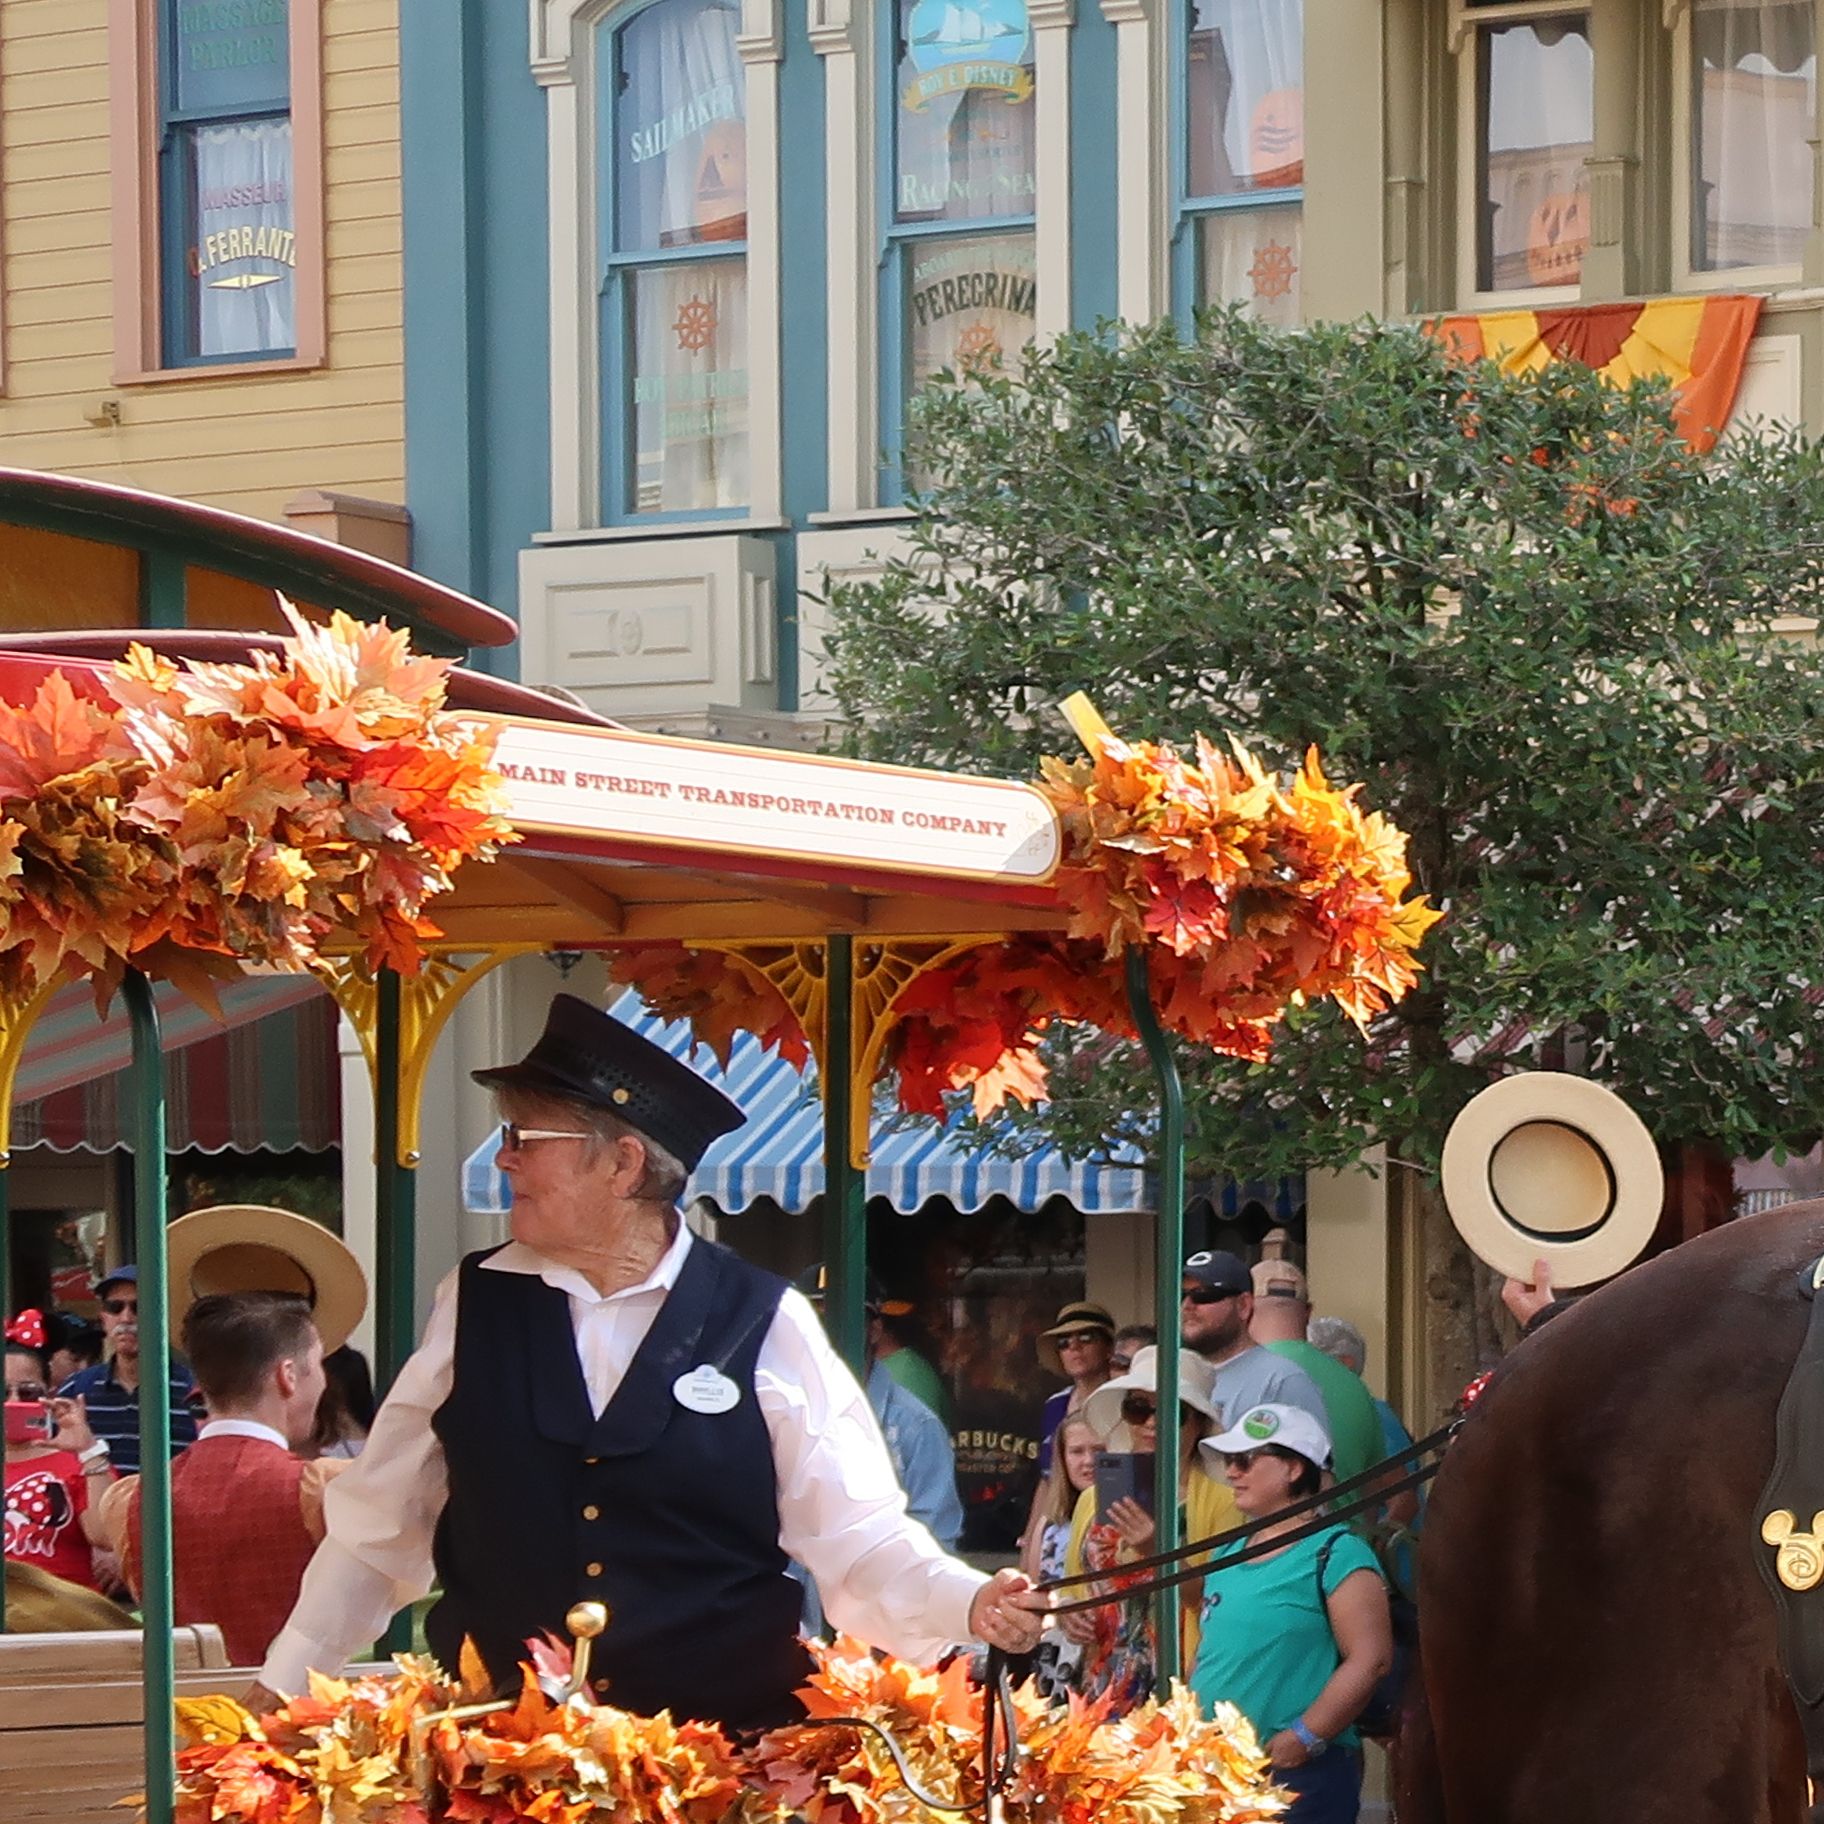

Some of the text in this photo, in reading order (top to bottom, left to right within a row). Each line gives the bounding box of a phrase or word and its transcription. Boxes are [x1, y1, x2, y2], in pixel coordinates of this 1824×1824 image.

[964, 65, 1015, 87] DISNEY
[631, 83, 737, 163] SAILMAKER
[913, 272, 1037, 326] PEREGRINA
[498, 762, 1008, 838] MAIN STREET TRANSPORTATION COMPANY
